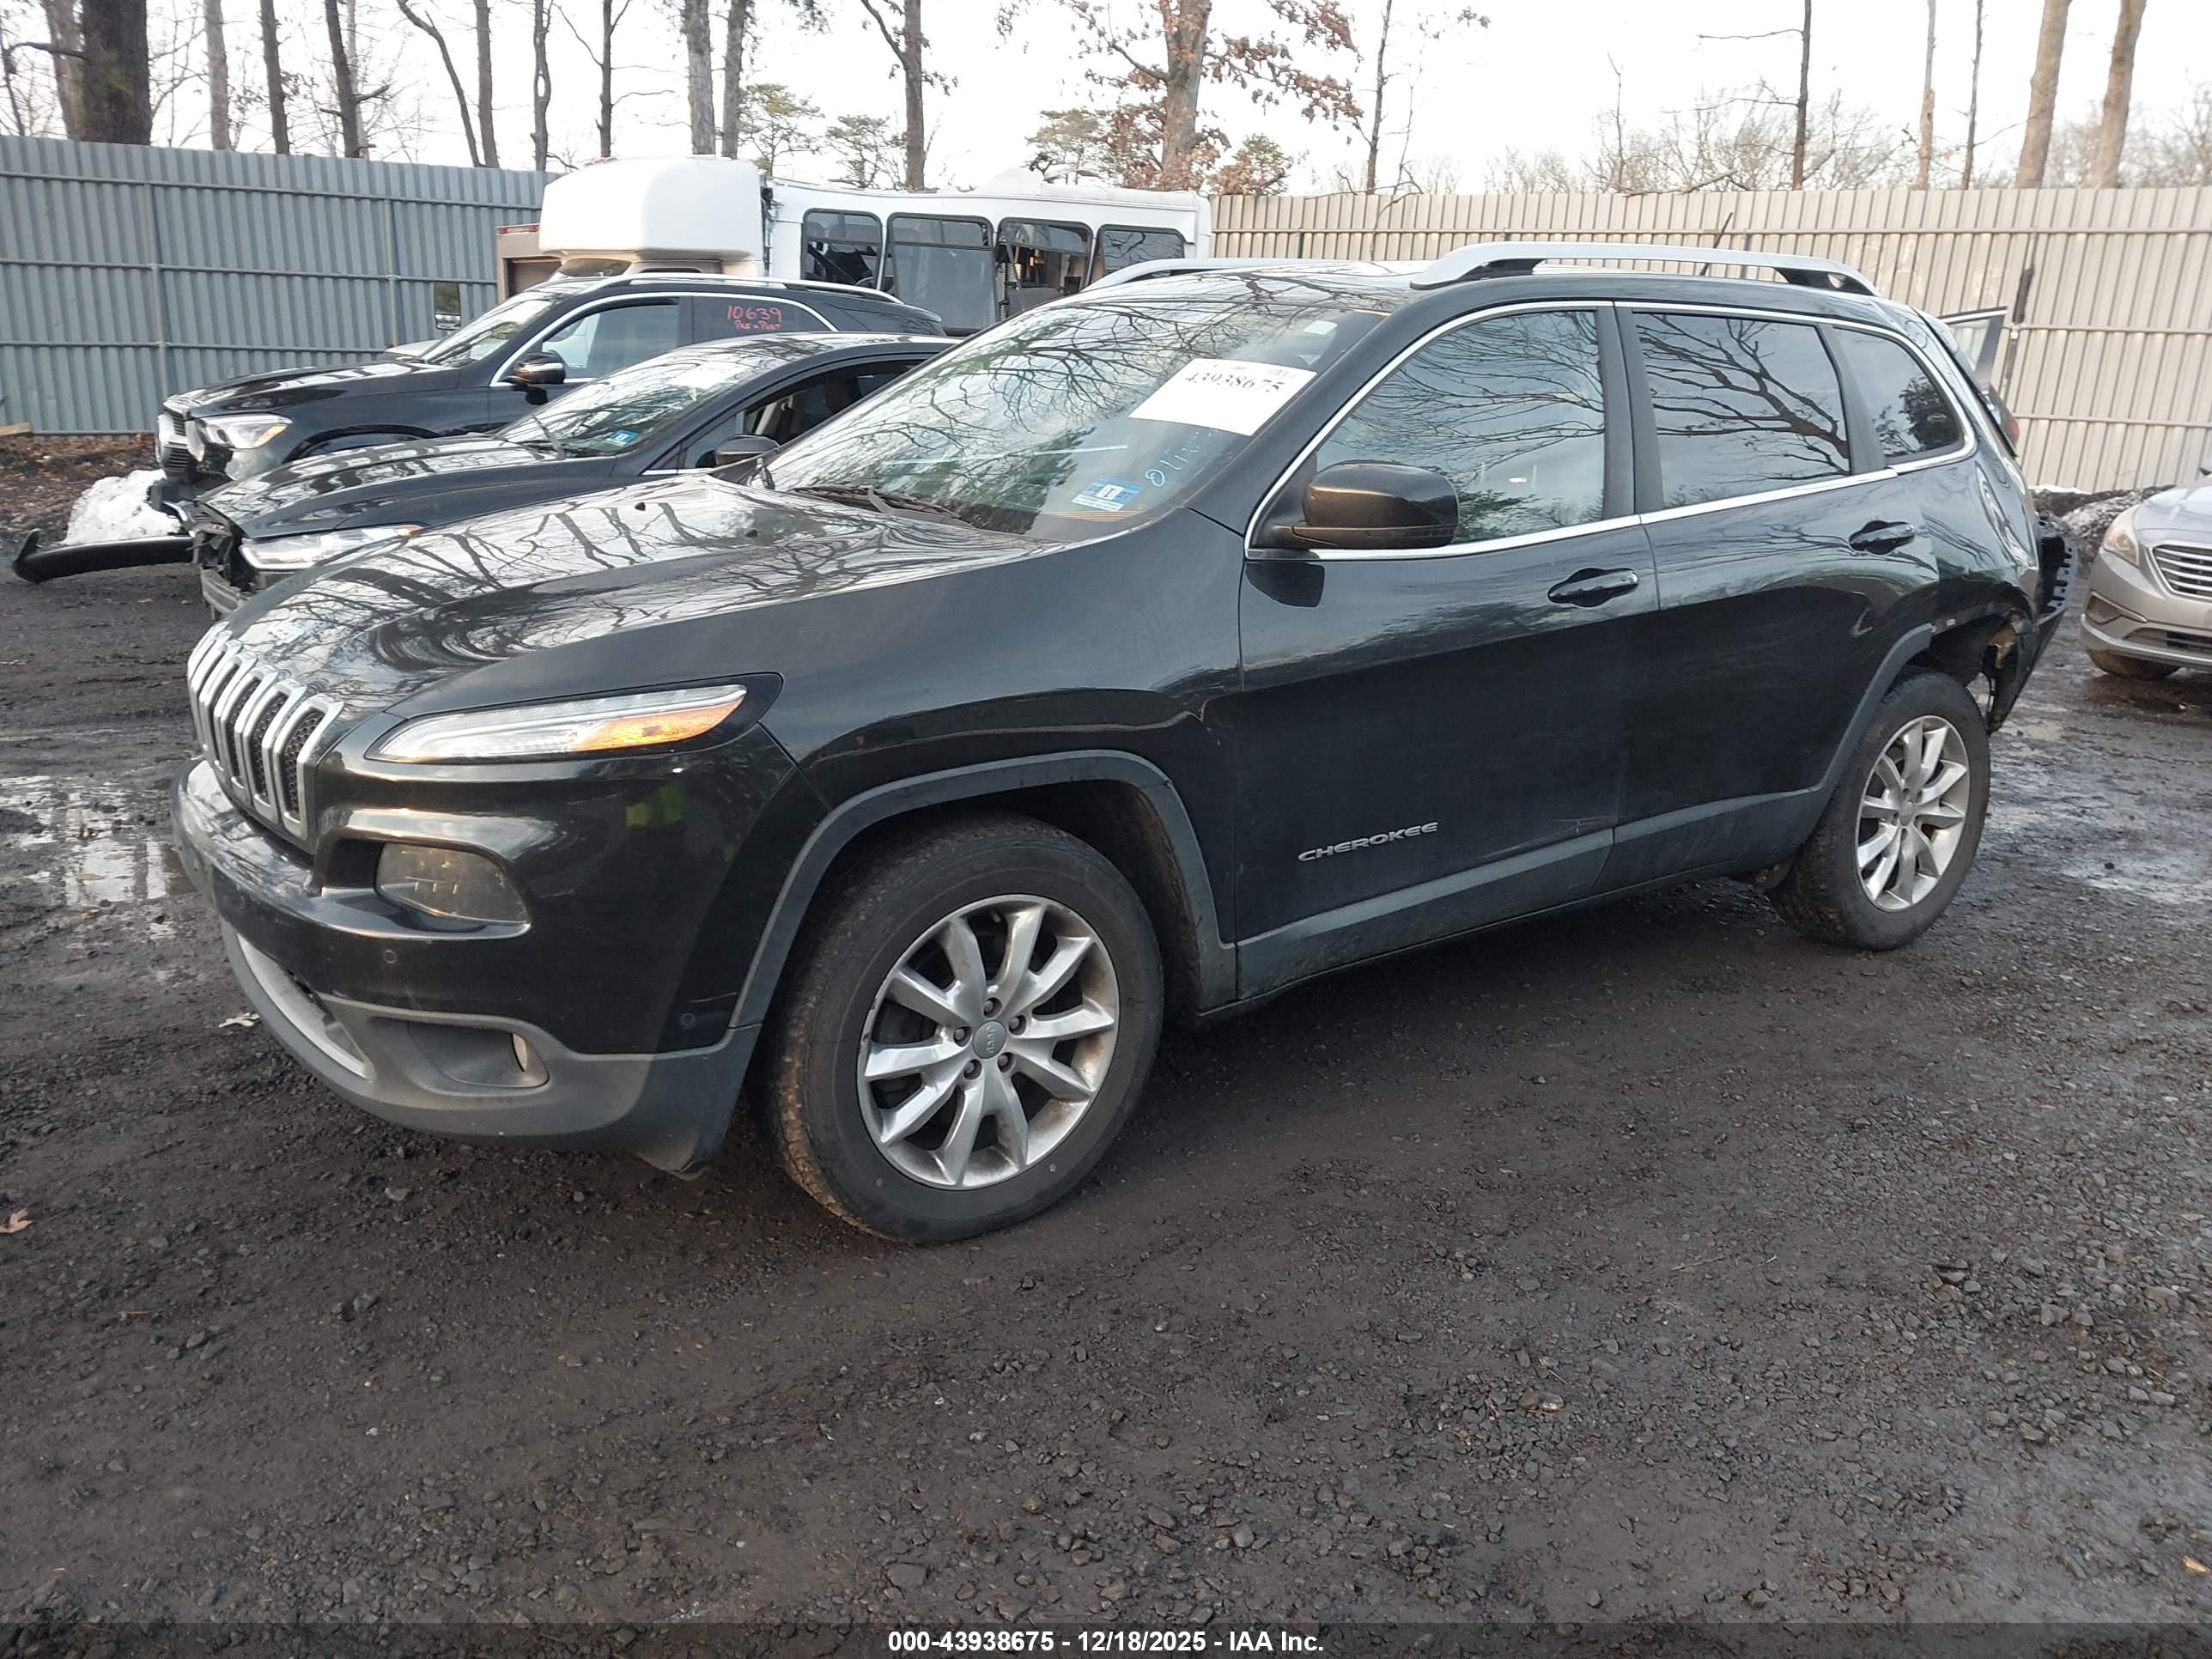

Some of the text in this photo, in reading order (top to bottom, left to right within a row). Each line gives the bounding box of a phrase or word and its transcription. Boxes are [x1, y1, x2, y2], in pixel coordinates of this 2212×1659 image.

[727, 305, 783, 322] 10639
[1184, 371, 1285, 393] 43938675
[1297, 822, 1439, 862] CHEROKEE
